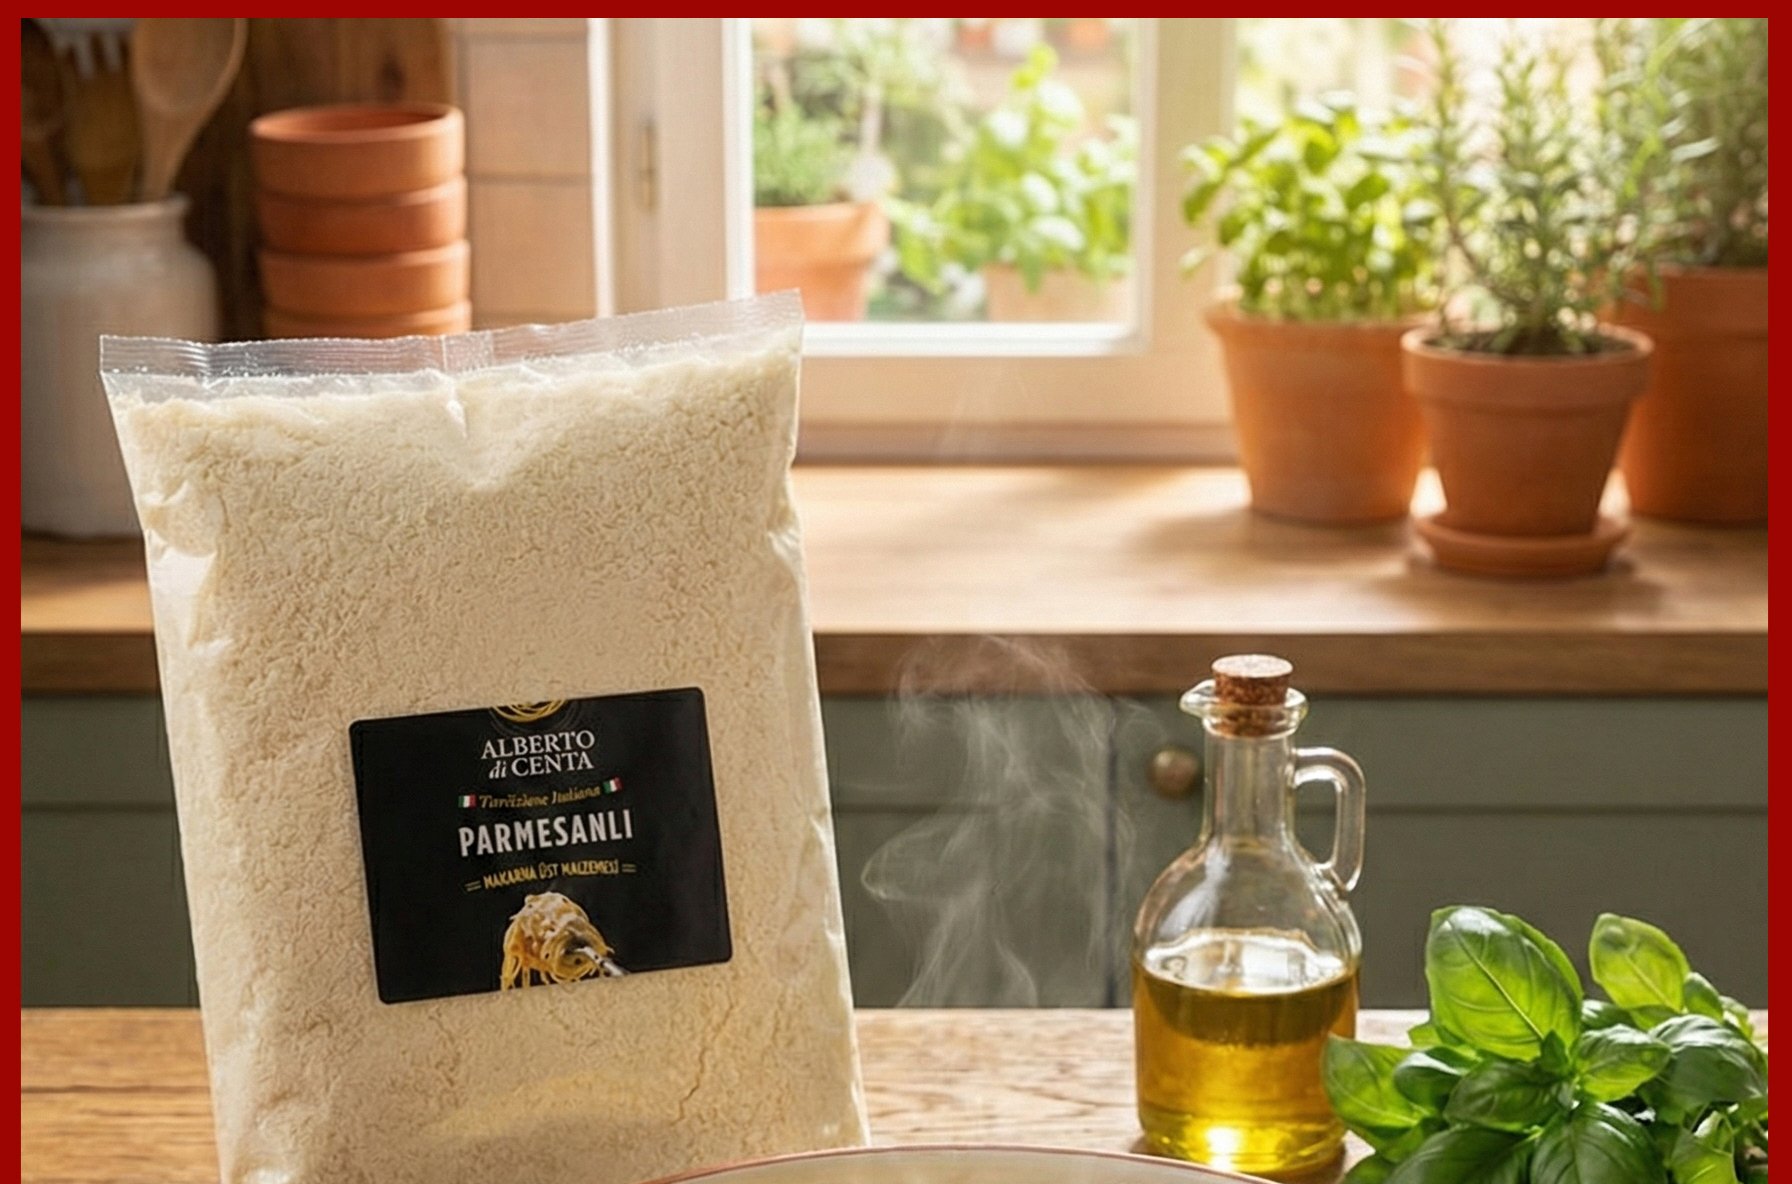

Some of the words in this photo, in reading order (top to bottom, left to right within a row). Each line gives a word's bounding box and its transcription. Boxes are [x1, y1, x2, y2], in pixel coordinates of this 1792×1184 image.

[481, 730, 596, 759] ALBERTO
[488, 760, 507, 779] di
[511, 751, 595, 777] CENTA
[458, 809, 633, 857] PARMESANLI
[483, 866, 537, 889] MAKARNA
